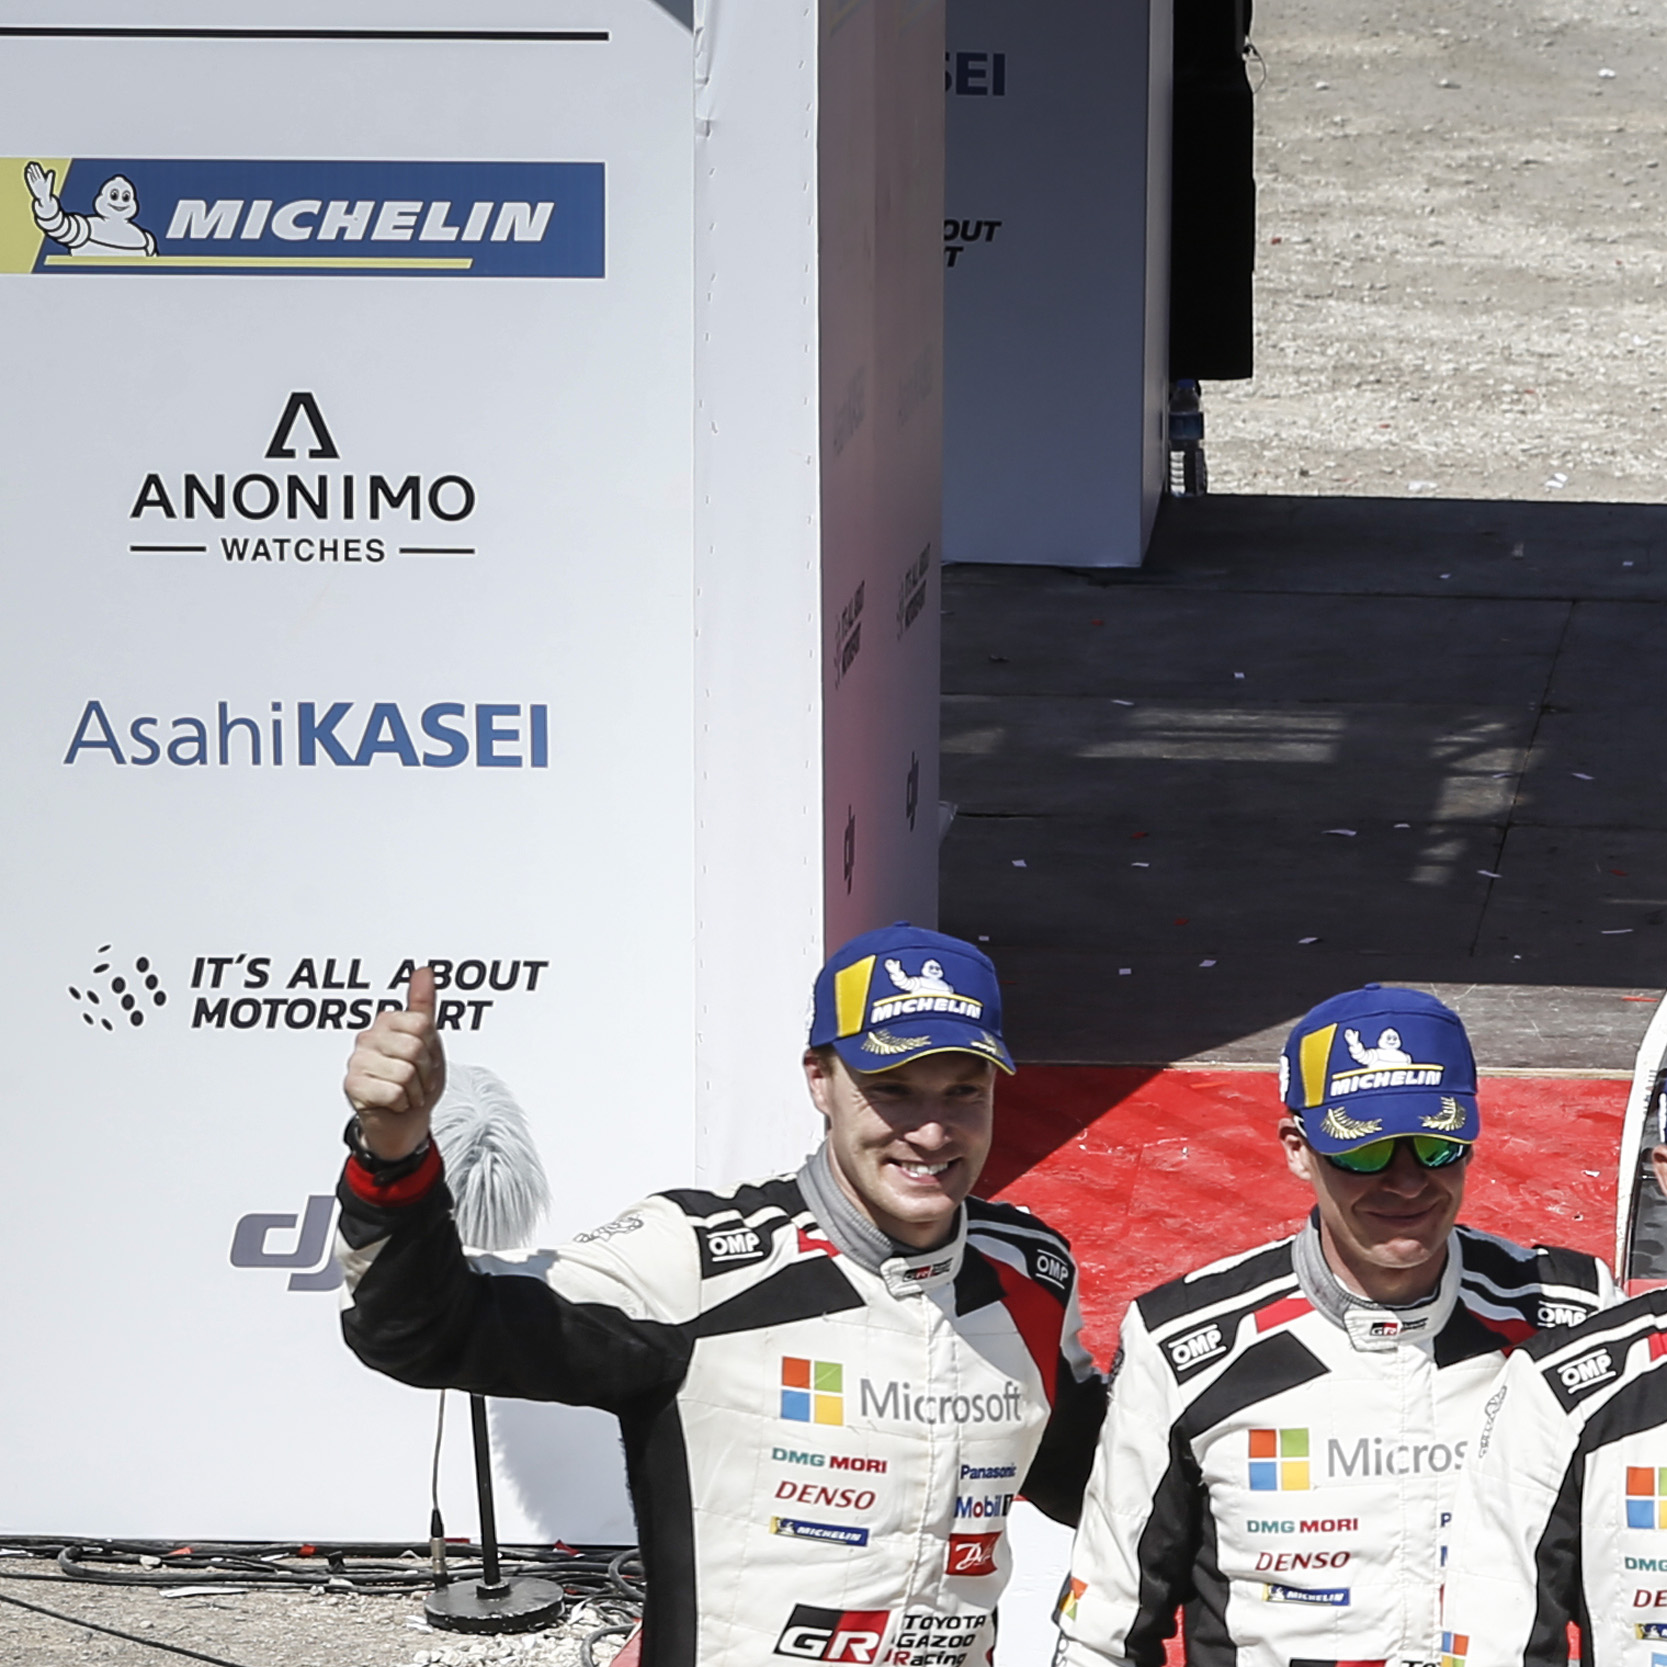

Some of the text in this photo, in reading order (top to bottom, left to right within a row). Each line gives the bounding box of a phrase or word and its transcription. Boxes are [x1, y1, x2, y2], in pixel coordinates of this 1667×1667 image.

[165, 200, 554, 243] MICHELIN
[130, 473, 476, 521] ANONIMO
[221, 538, 386, 563] WATCHES
[286, 957, 371, 990] ALL
[388, 959, 549, 992] ABOUT
[191, 999, 494, 1032] MOTORSPRT
[870, 995, 983, 1023] MICHELIN
[1331, 1068, 1445, 1097] MICHELIN
[707, 1232, 762, 1259] OMP
[1035, 1254, 1069, 1283] OMP
[1170, 1327, 1223, 1367] OMP
[1561, 1354, 1613, 1386] OMP
[859, 1378, 1022, 1426] Microsoft
[771, 1447, 888, 1474] DMG MORI
[774, 1480, 876, 1511] DENSO
[797, 1525, 862, 1543] MICHELIN
[1246, 1517, 1359, 1535] DMG MORI
[1255, 1550, 1351, 1572] DENSO
[778, 1614, 986, 1664] GR TOYOTA
[897, 1632, 976, 1649] GAZOO
